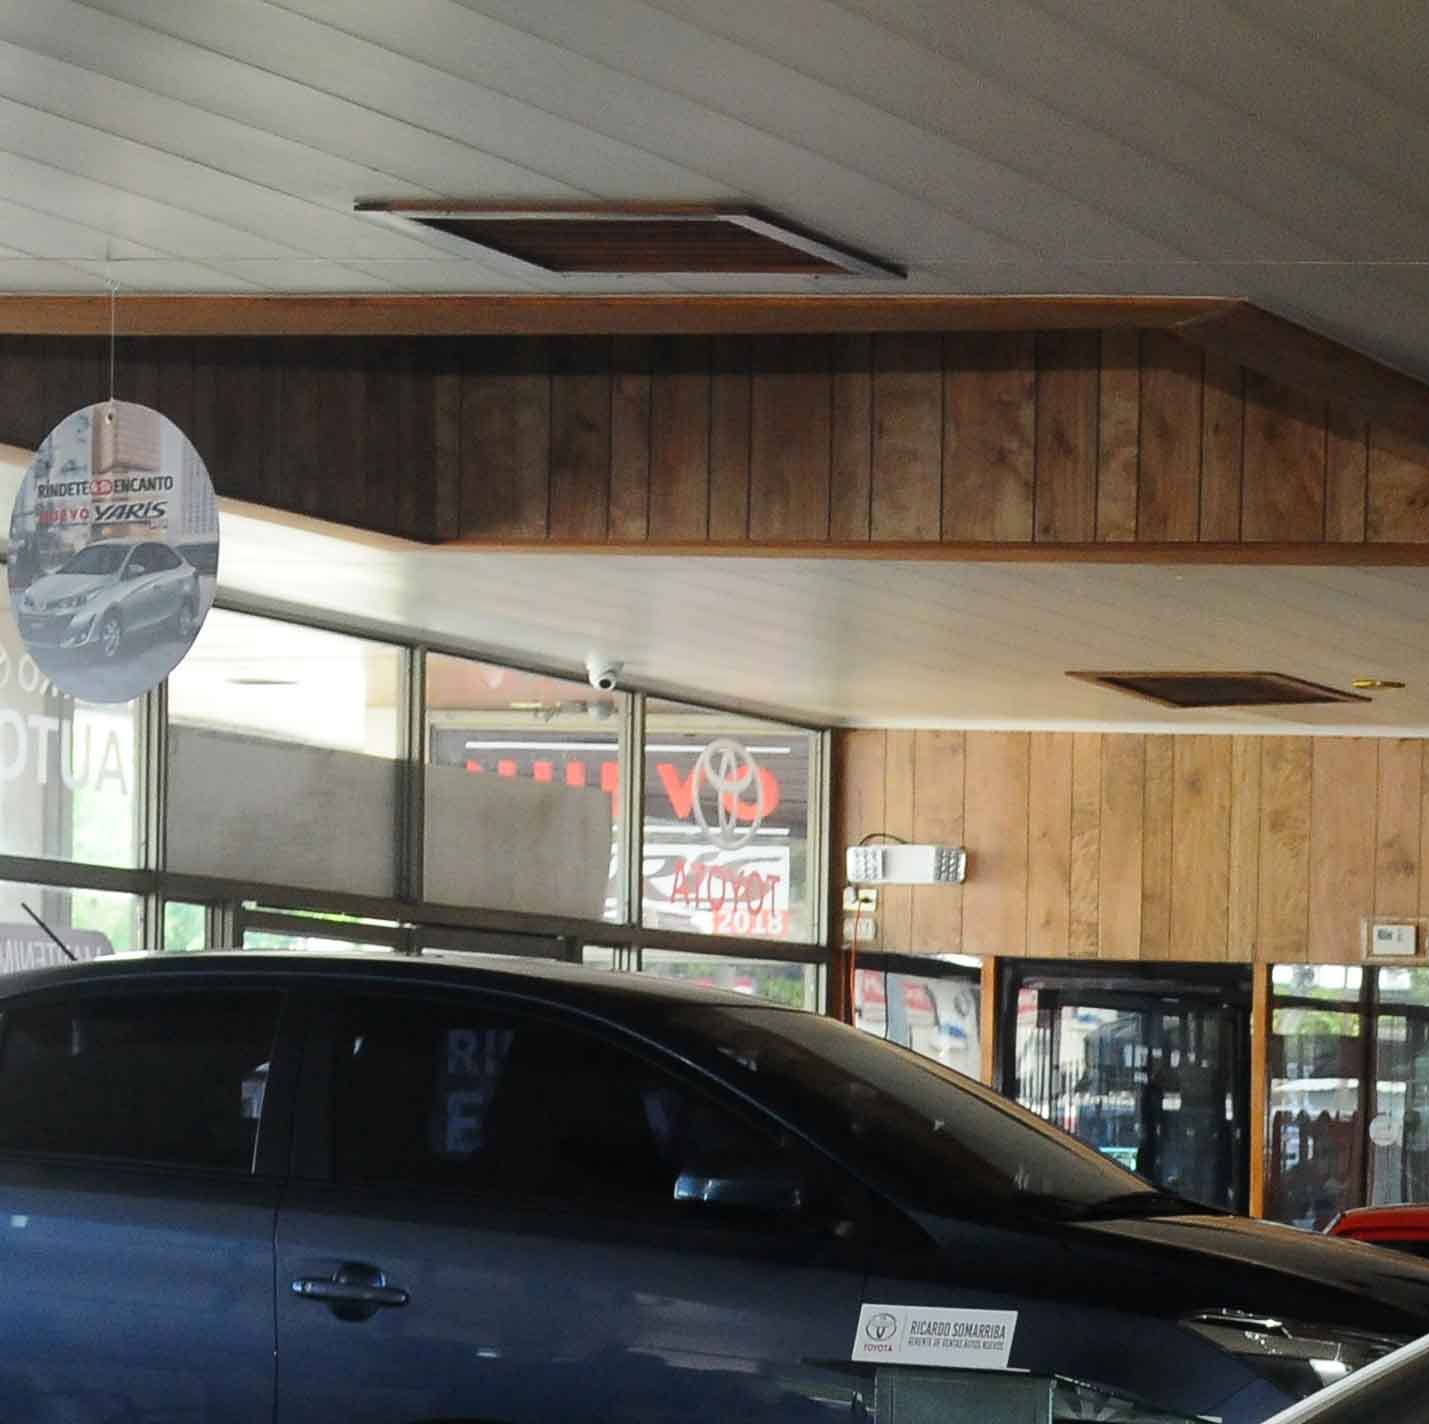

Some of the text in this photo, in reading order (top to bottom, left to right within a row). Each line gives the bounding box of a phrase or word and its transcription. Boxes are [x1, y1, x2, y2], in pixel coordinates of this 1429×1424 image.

[114, 475, 174, 493] ENCANTO
[719, 910, 784, 936] 2018
[910, 1319, 951, 1336] RICARDO
[863, 1343, 893, 1353] TOYOTA
